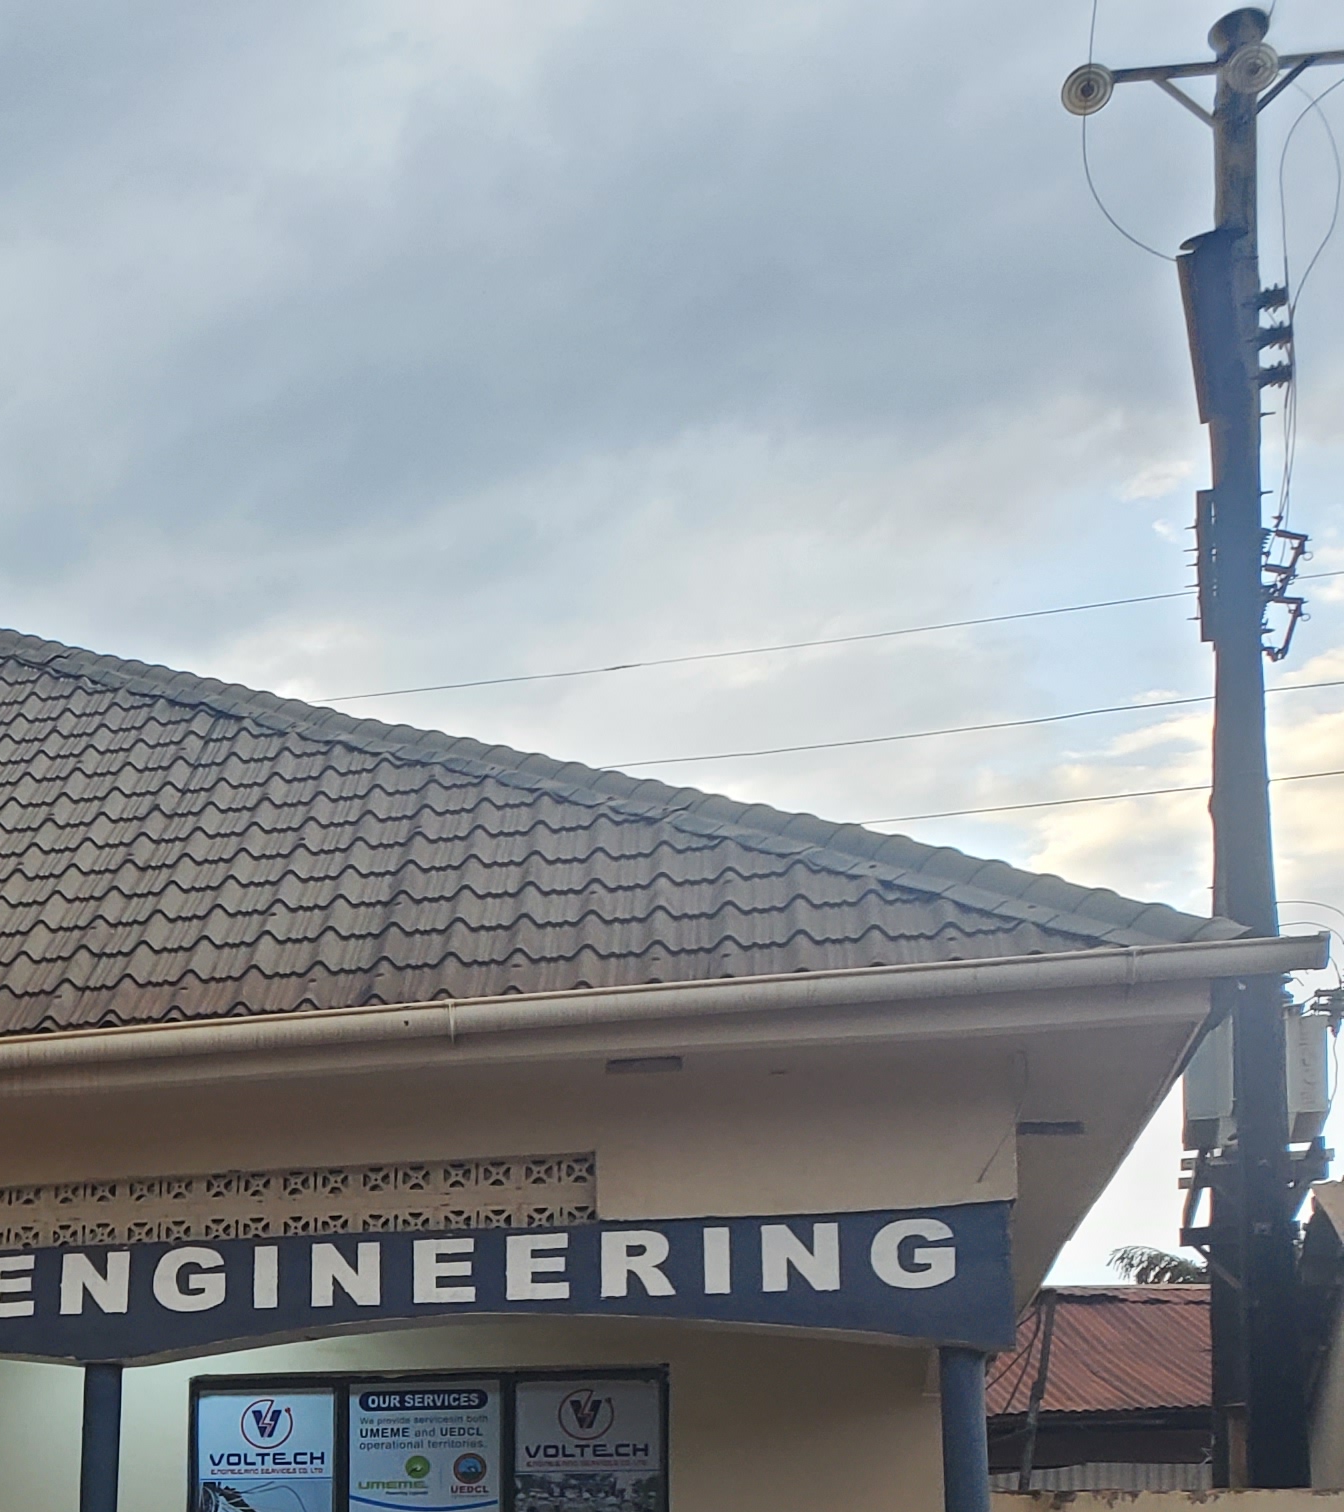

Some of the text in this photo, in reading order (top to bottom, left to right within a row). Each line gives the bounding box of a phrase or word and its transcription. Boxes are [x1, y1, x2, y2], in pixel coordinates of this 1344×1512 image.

[368, 1393, 478, 1408] OUR SERVICES
[377, 1416, 410, 1426] provide
[360, 1427, 483, 1438] UMEME and UEDCL
[360, 1440, 423, 1451] operational
[525, 1443, 648, 1458] VOLTECH
[210, 1452, 325, 1466] VOLTECH
[451, 1485, 489, 1494] UEDCL
